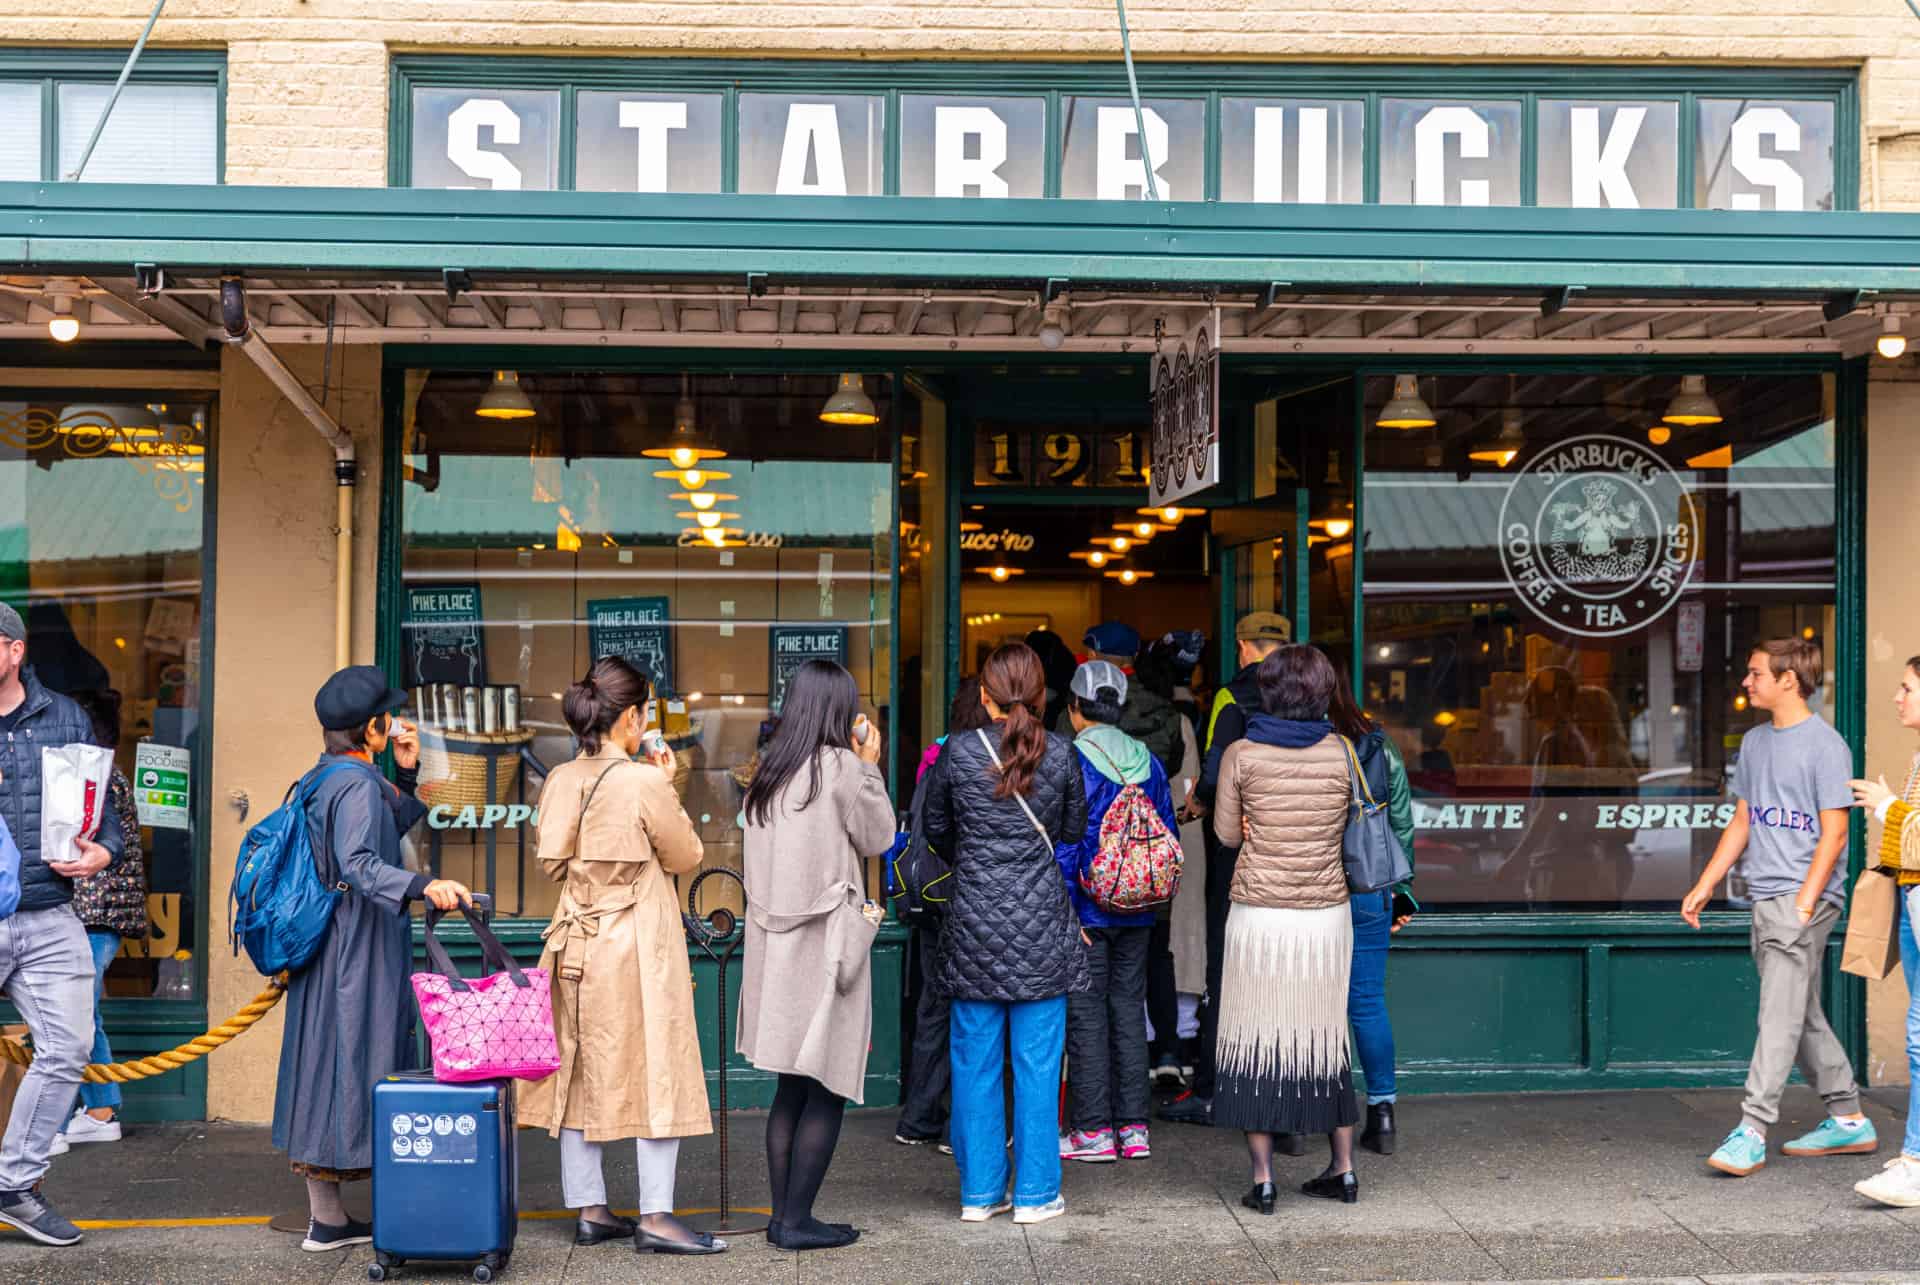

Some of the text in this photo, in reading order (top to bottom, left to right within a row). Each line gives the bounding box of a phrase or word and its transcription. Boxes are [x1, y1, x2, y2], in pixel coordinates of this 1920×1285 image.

[446, 98, 1804, 209] STARBUCKS
[1536, 444, 1662, 487] STARBUCKS
[1507, 522, 1689, 627] COFFEE TEA SPICES
[412, 594, 473, 611] PIKE PLACE
[597, 609, 660, 628] PIKE PLACE
[778, 634, 839, 652] PIKE PLACE
[1414, 804, 1525, 829] LATTE
[1748, 806, 1815, 833] NCLER
